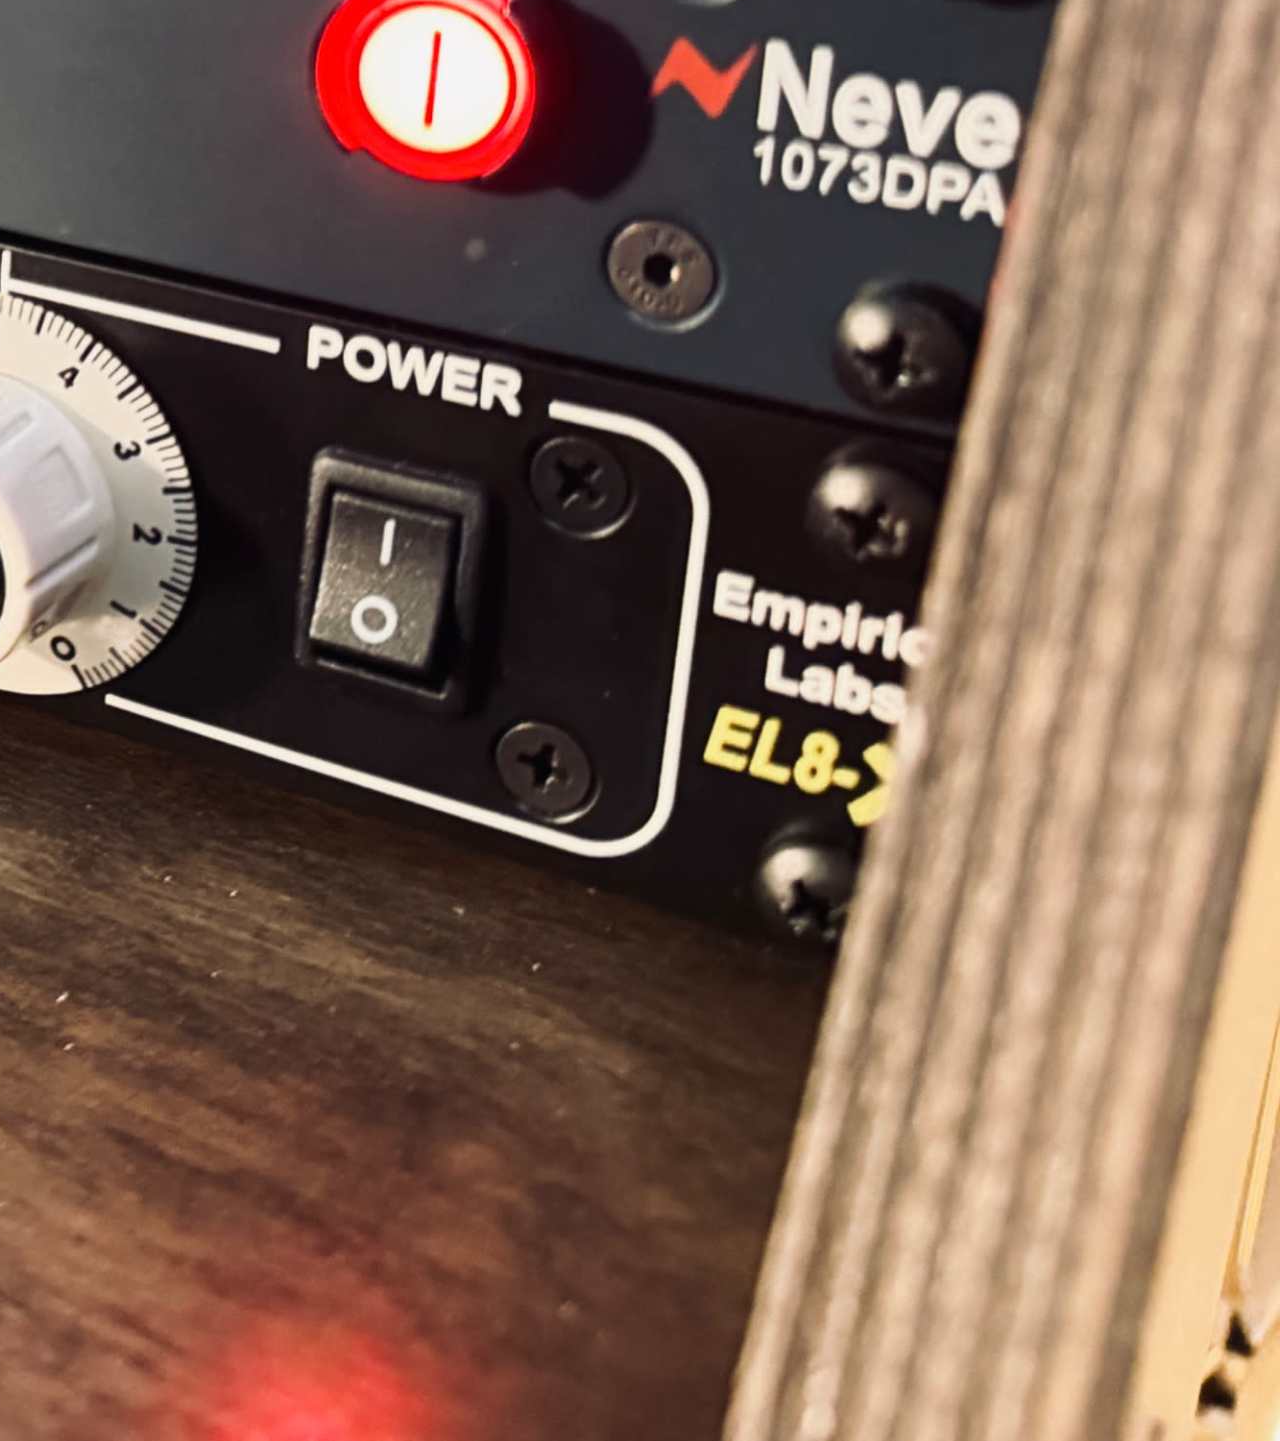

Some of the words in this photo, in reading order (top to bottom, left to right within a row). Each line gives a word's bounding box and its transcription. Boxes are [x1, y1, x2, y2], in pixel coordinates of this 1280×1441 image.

[755, 36, 1023, 171] Neve
[56, 364, 82, 390] 4
[306, 324, 523, 418] POWER
[113, 440, 143, 461] 3
[131, 521, 163, 547] 2
